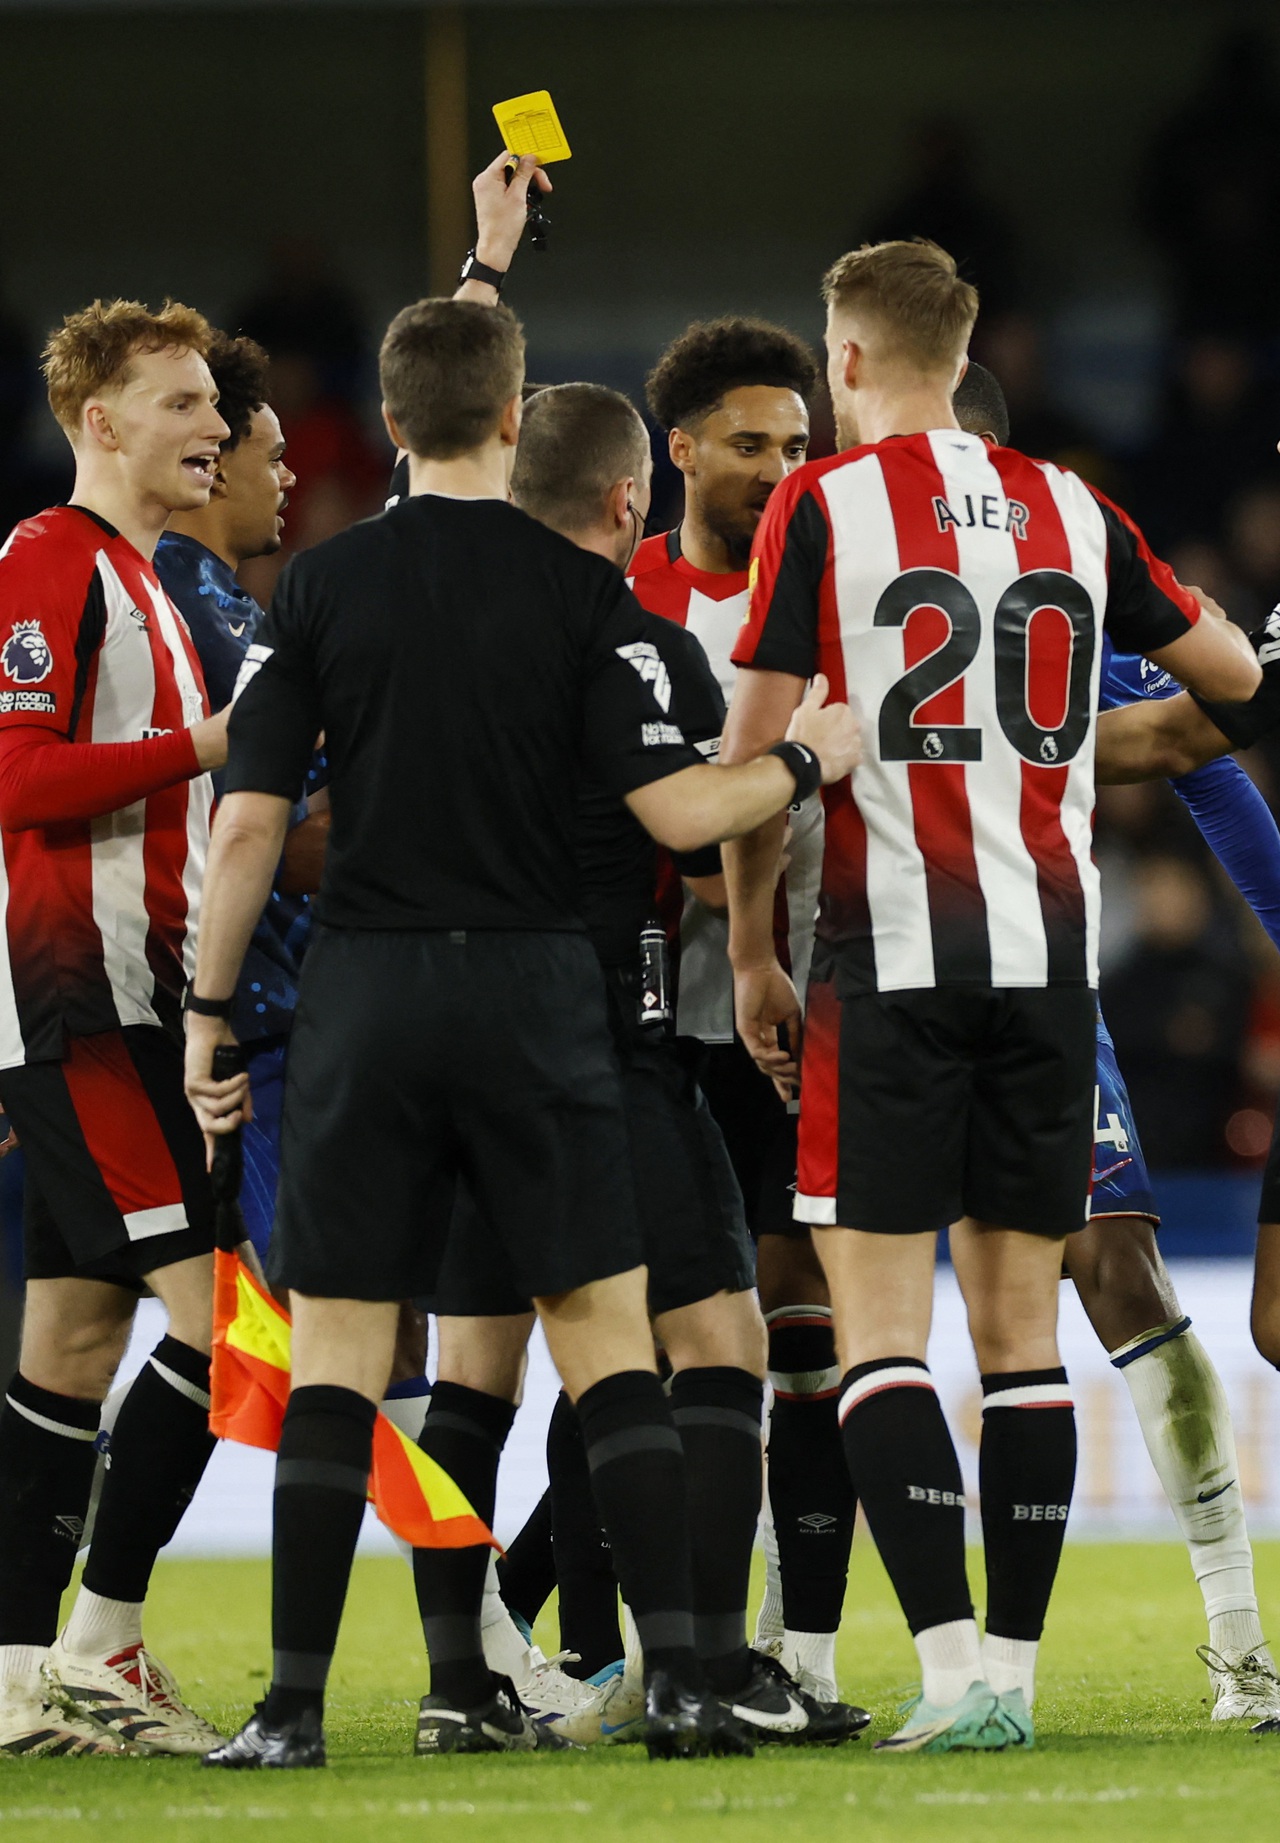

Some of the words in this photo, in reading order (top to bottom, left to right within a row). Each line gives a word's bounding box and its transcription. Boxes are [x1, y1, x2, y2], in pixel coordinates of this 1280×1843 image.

[932, 494, 1030, 541] AJER
[873, 566, 1096, 769] 20
[0, 691, 14, 703] No
[15, 691, 51, 703] room
[15, 701, 56, 714] racism
[1011, 1503, 1069, 1522] BEES
